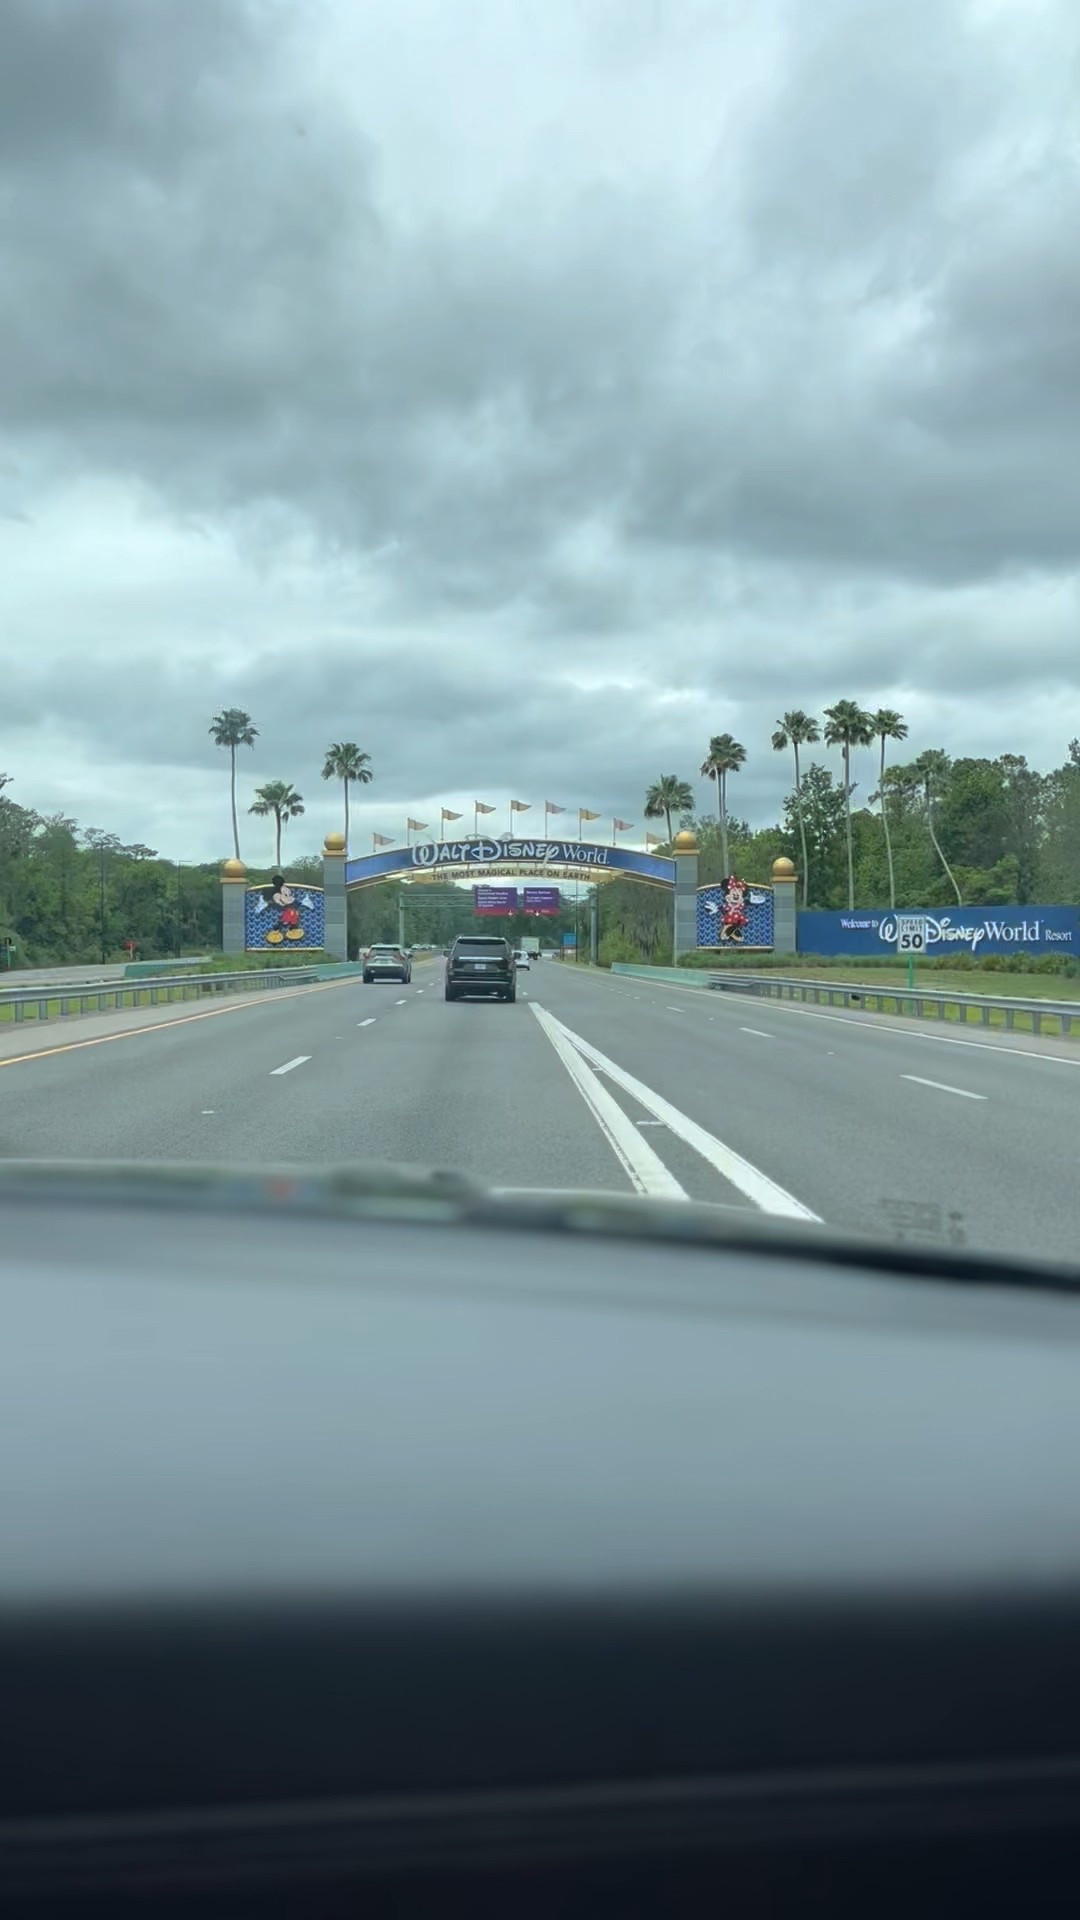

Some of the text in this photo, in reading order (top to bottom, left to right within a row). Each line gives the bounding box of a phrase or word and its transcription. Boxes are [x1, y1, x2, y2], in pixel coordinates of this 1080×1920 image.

[432, 868, 591, 881] THE MOST MAGICAL PLACE ON EARTH
[840, 918, 879, 929] Welcome to
[983, 920, 1041, 942] World
[1045, 929, 1073, 942] Resort
[901, 933, 923, 949] 50
